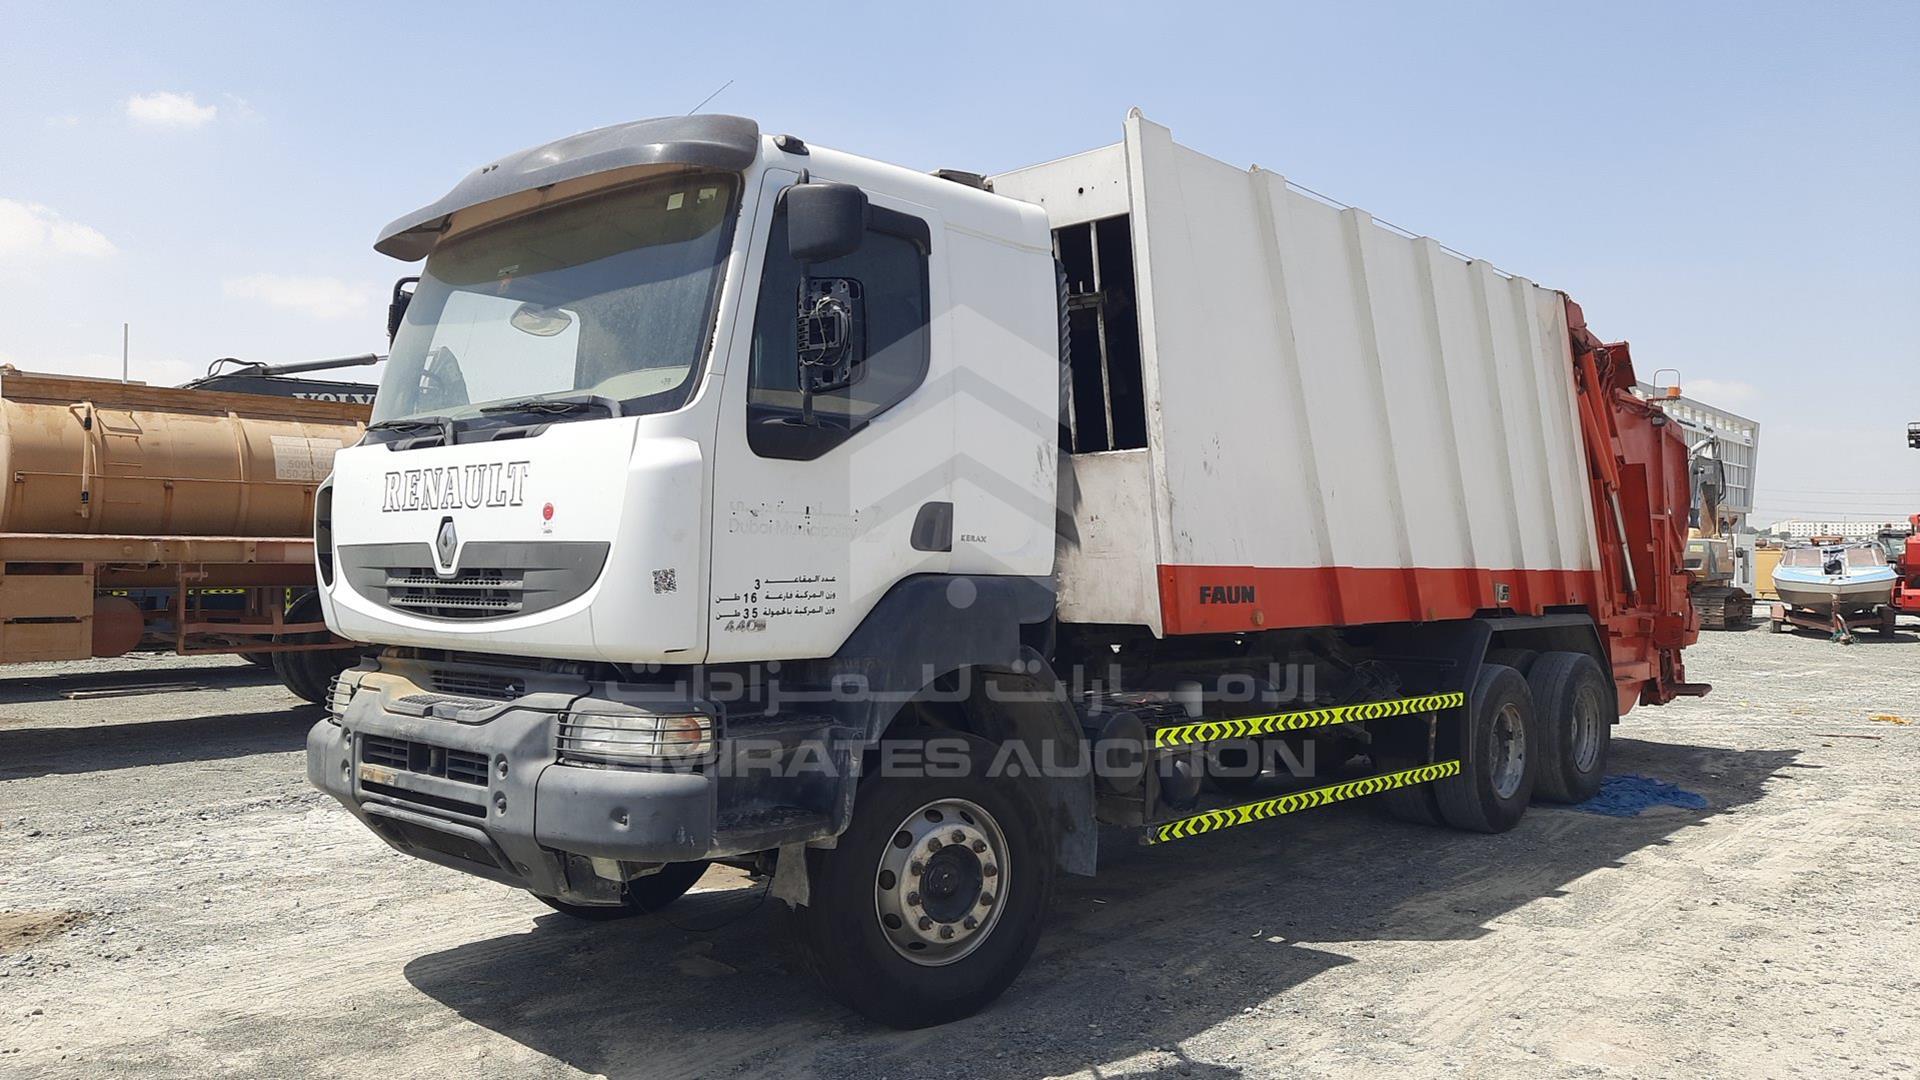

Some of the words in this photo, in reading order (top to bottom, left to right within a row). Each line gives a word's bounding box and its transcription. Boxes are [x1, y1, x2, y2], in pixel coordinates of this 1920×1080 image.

[382, 461, 530, 512] RENAULT
[754, 579, 761, 590] 3
[743, 592, 758, 603] 16
[1199, 586, 1256, 604] FAUN
[743, 607, 758, 619] 35
